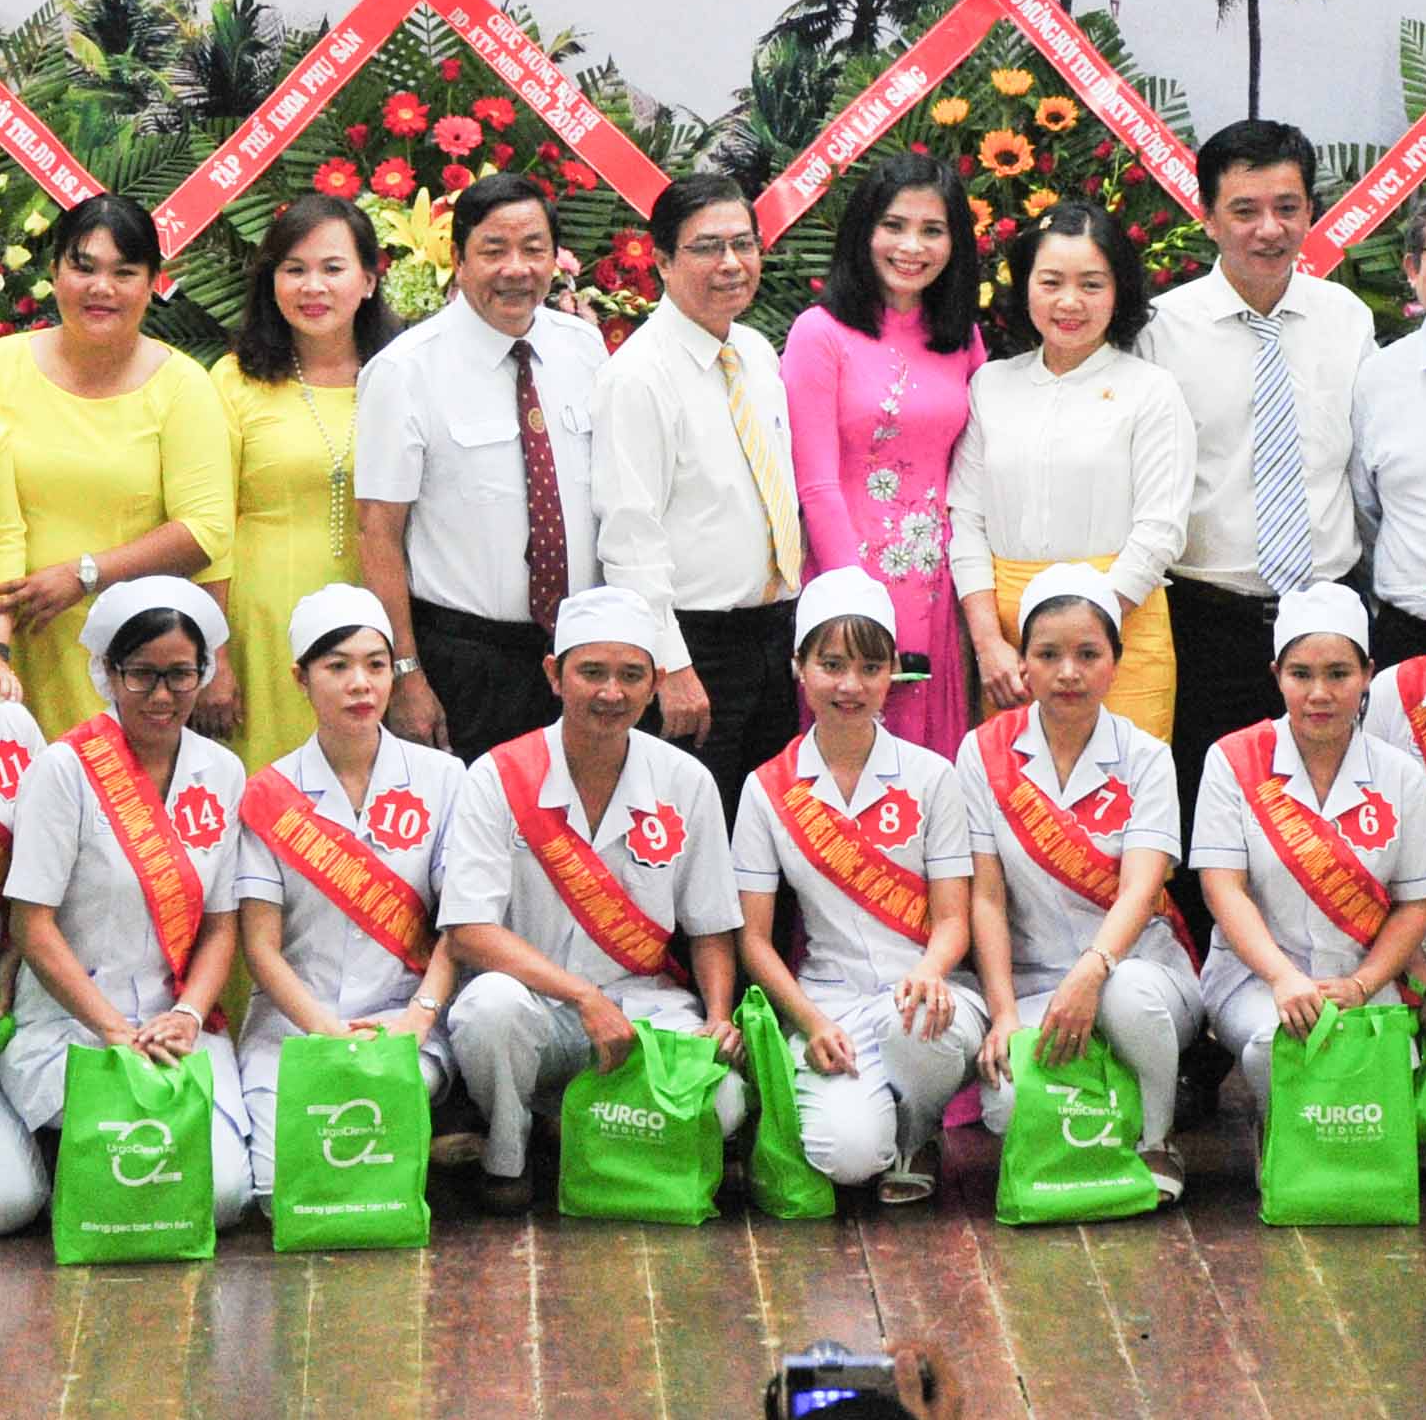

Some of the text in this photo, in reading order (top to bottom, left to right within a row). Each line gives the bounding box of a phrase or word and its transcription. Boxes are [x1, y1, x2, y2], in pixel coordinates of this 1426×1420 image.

[206, 26, 365, 191] TẬP THỂ KHOA PHỤ SẢN
[544, 100, 588, 146] 2018
[572, 102, 600, 131] THI
[1046, 30, 1080, 65] HỘI
[1067, 54, 1098, 85] THI
[1160, 155, 1204, 199] SINH
[181, 799, 218, 836] 14
[879, 803, 899, 833] 8
[1094, 789, 1116, 819] 7
[1359, 804, 1379, 835] 6
[377, 804, 421, 839] 10
[642, 816, 667, 849] 9
[602, 1104, 665, 1130] URGO
[1316, 1103, 1383, 1124] URGO
[1316, 1124, 1383, 1133] MEDICAL
